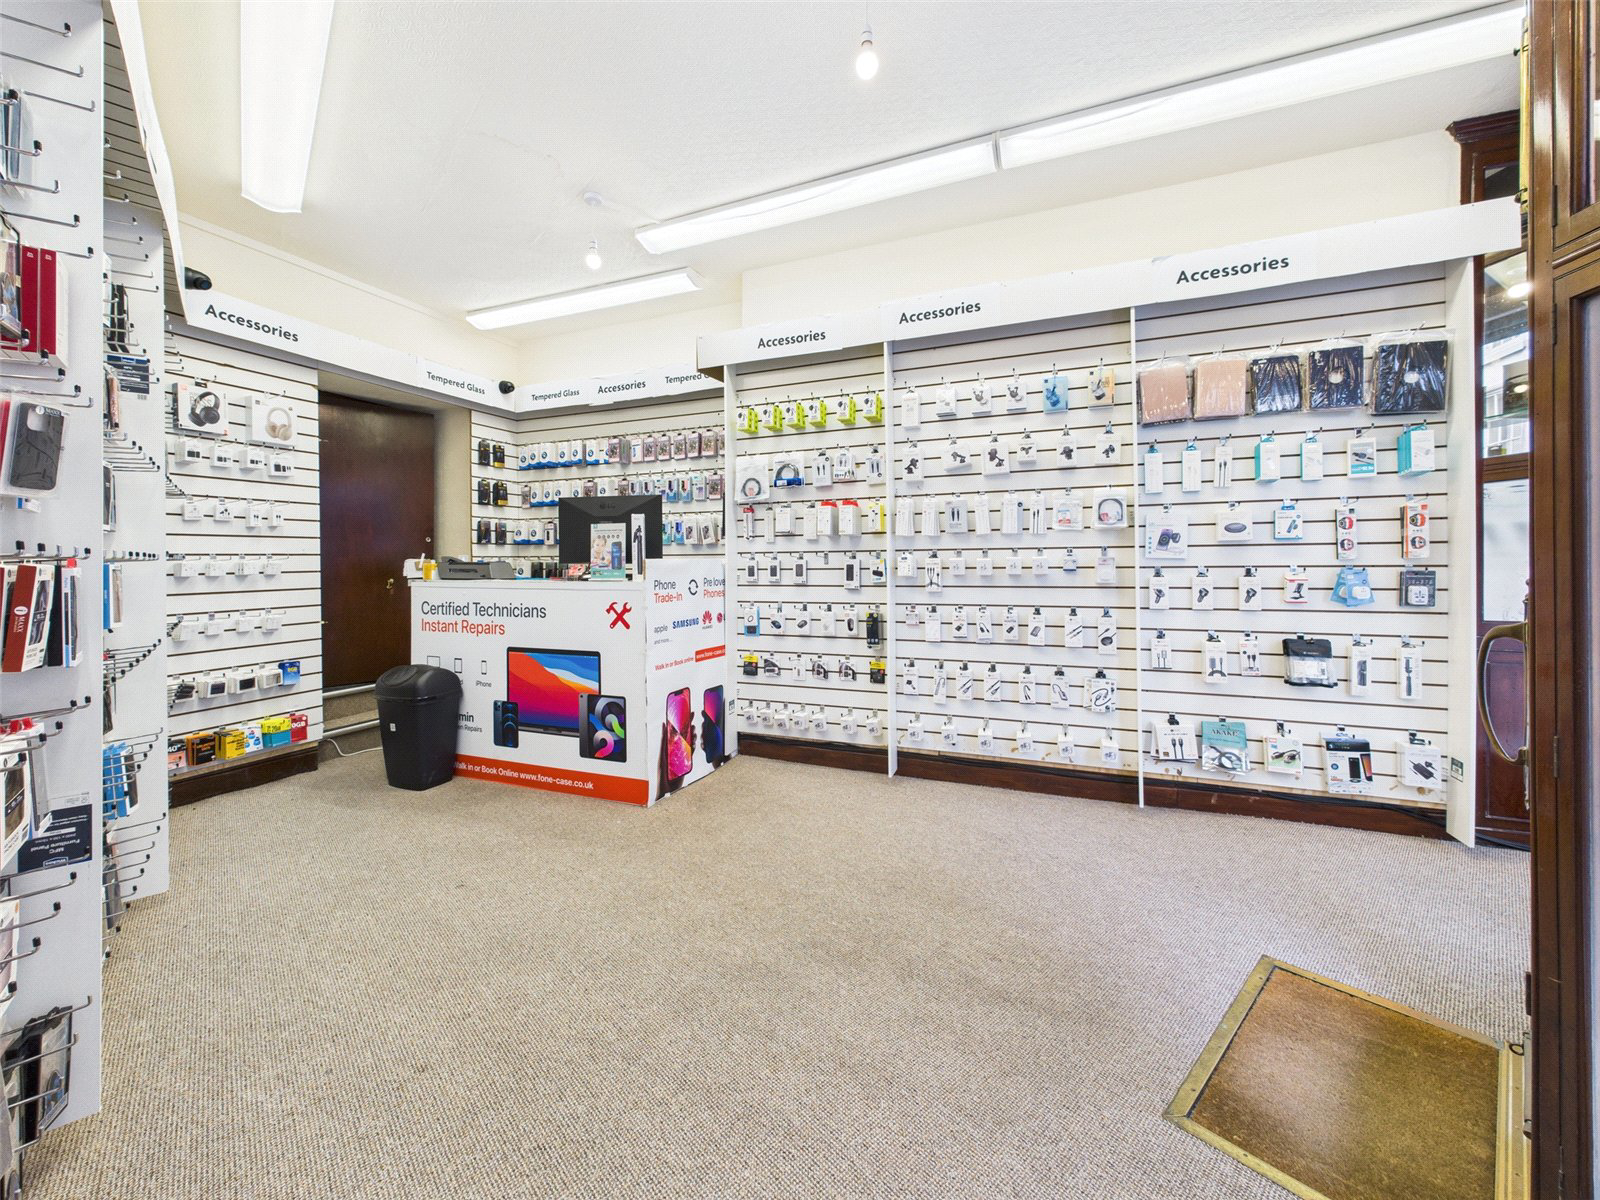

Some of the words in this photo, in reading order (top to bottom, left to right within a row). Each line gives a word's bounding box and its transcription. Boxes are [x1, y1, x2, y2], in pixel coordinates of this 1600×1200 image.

[1176, 255, 1290, 285] Accessories
[899, 301, 981, 325] Accessories
[204, 304, 299, 342] Accessories
[757, 329, 826, 349] Accessories
[427, 371, 465, 389] Tempered
[466, 383, 485, 395] Glass
[664, 372, 702, 385] Tempered
[597, 380, 646, 394] Accessories
[531, 390, 562, 402] Tempered
[562, 388, 580, 398] Glass
[653, 579, 676, 591] Phone
[703, 577, 713, 588] Pre
[654, 592, 683, 604] Trade-In
[703, 589, 725, 599] Phones
[421, 600, 469, 616] Certified
[472, 602, 547, 619] Technicians
[421, 618, 459, 633] Instant
[461, 619, 505, 637] Repairs
[653, 624, 668, 634] apple
[672, 617, 699, 630] SAMSUNG
[475, 680, 492, 688] iPhone
[464, 724, 483, 733] Repairs
[473, 765, 481, 773] or
[481, 765, 498, 775] Book
[498, 767, 519, 778] Online
[519, 773, 594, 790] www.fone-case.co.uk
